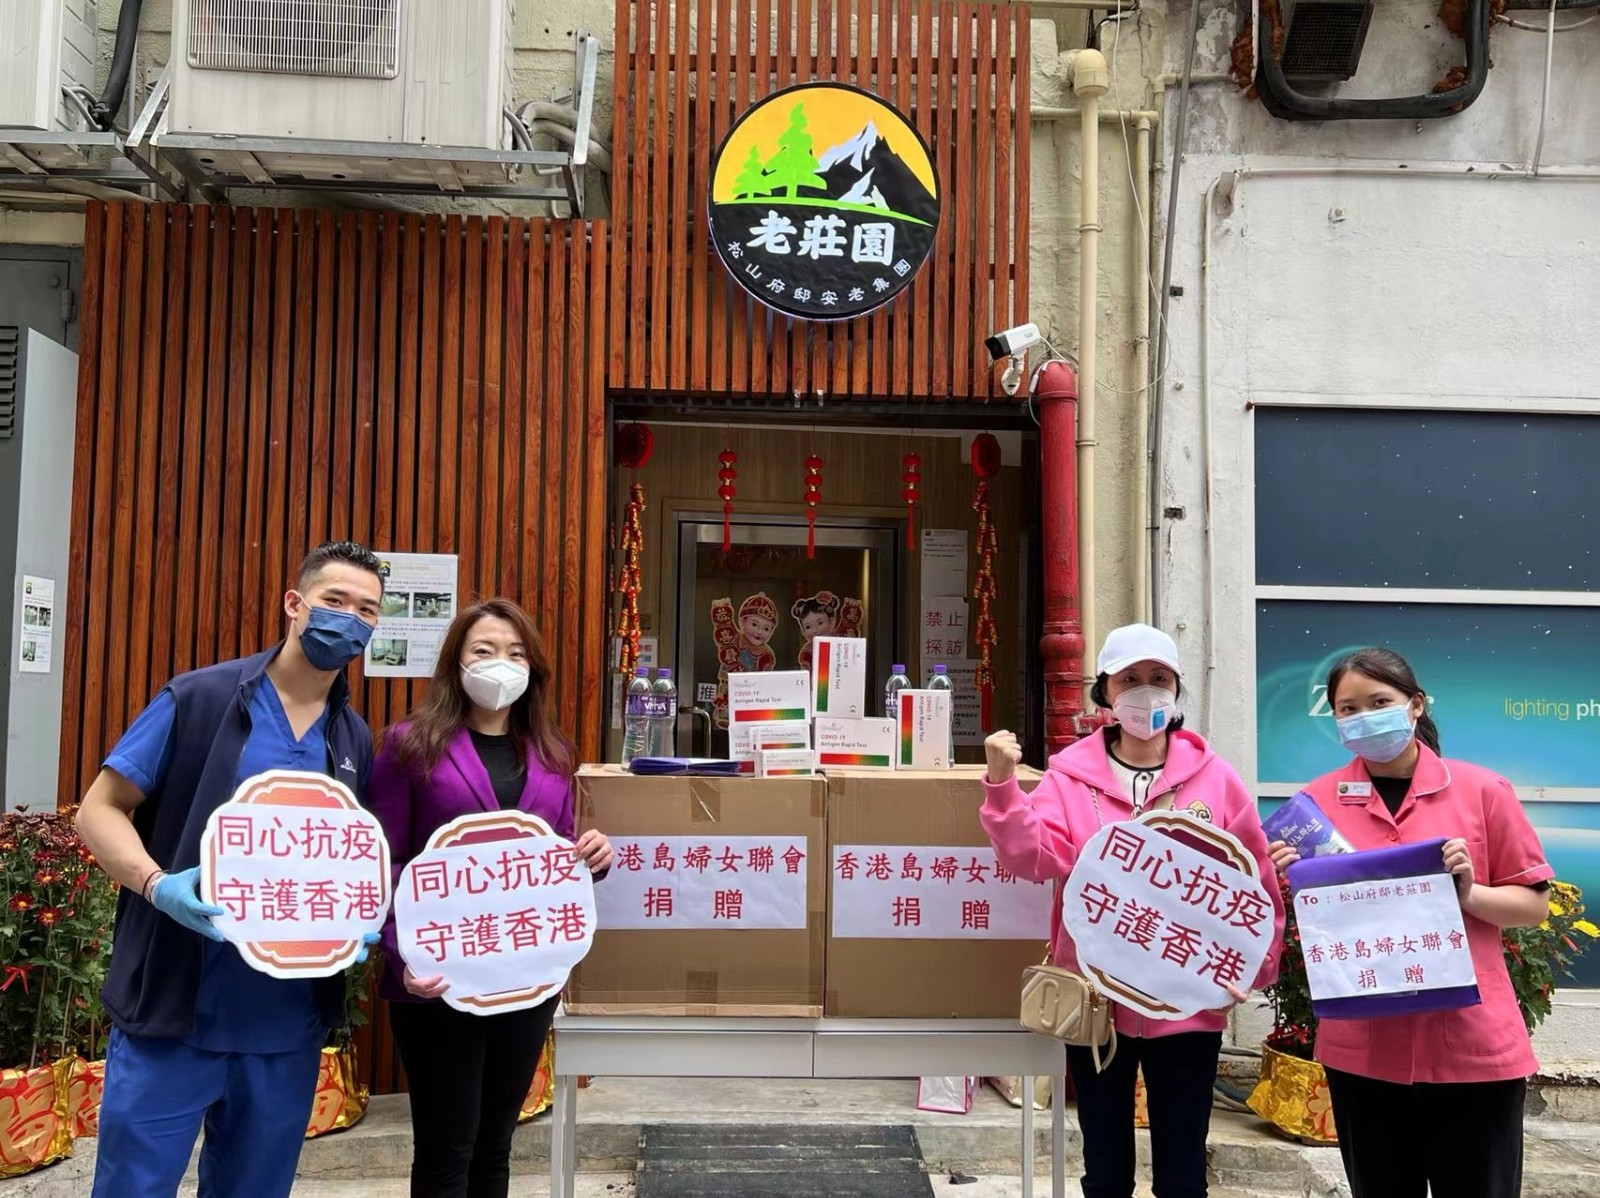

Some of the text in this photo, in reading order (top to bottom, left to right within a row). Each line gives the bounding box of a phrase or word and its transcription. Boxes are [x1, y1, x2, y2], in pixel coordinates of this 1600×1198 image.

[746, 209, 896, 266] 老莊園
[926, 611, 963, 627] 禁止
[926, 639, 962, 655] 探訪
[700, 684, 716, 700] 推
[1504, 698, 1569, 720] lighting
[218, 815, 378, 861] 同心抗疫
[411, 844, 582, 902] 同心抗疫
[1099, 826, 1271, 938] 同心抗疫
[1339, 881, 1431, 902] 松山府邸老莊園
[218, 877, 380, 922] 守護香港
[416, 902, 587, 963] 守護香港
[1080, 882, 1246, 989] 守護香港
[1307, 929, 1464, 963] 香港島婦女聯會
